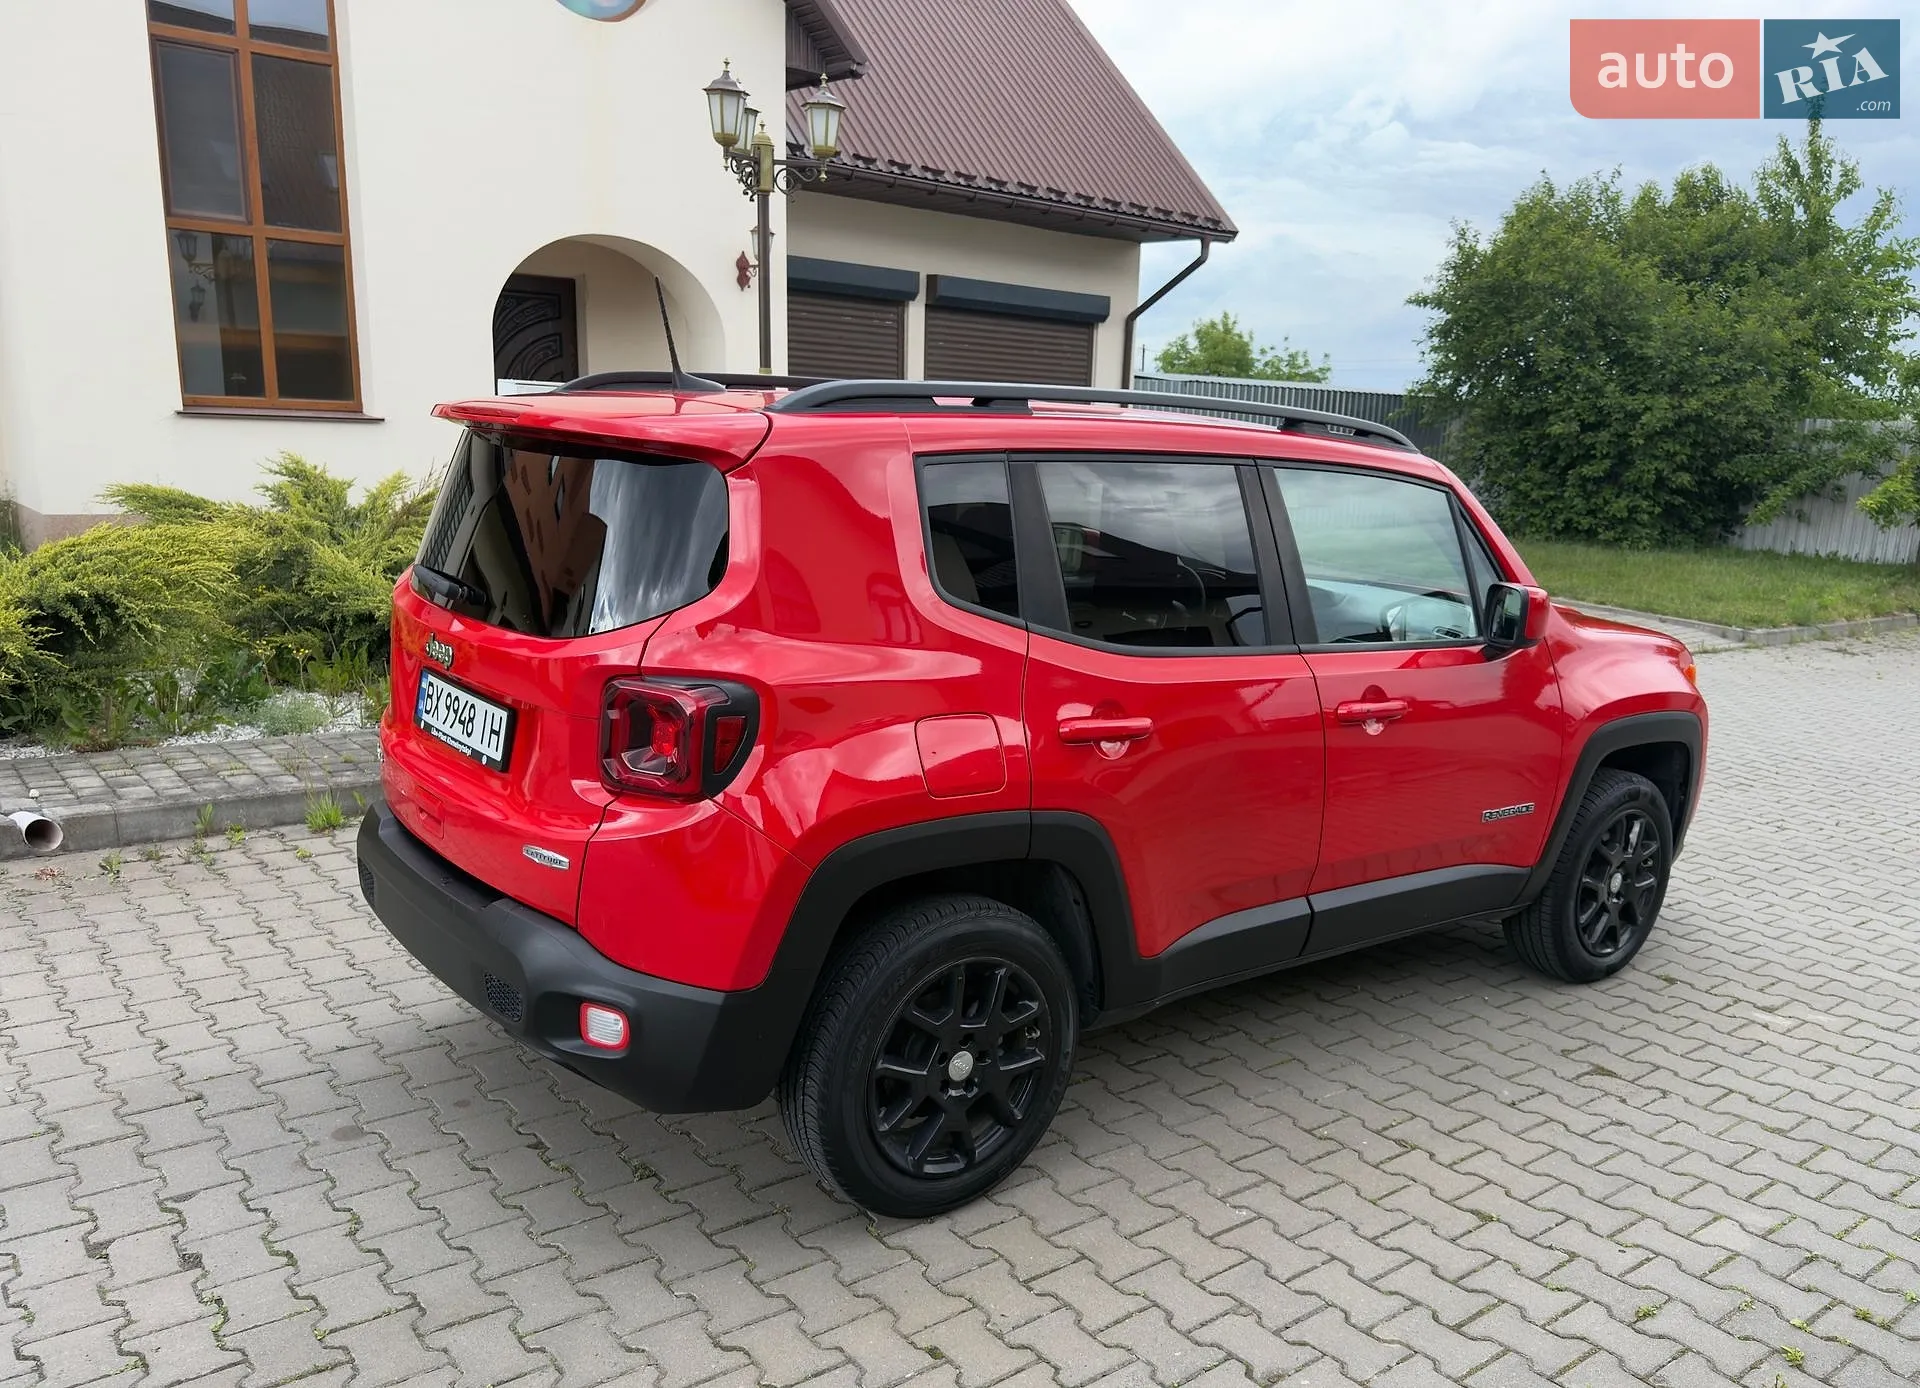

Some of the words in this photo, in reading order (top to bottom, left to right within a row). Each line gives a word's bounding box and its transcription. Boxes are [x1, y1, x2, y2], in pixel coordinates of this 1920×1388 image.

[426, 632, 453, 669] Jeep
[424, 681, 443, 721] BX
[442, 692, 476, 738] 9948
[480, 709, 502, 752] IH
[1482, 802, 1535, 822] RENEGADE
